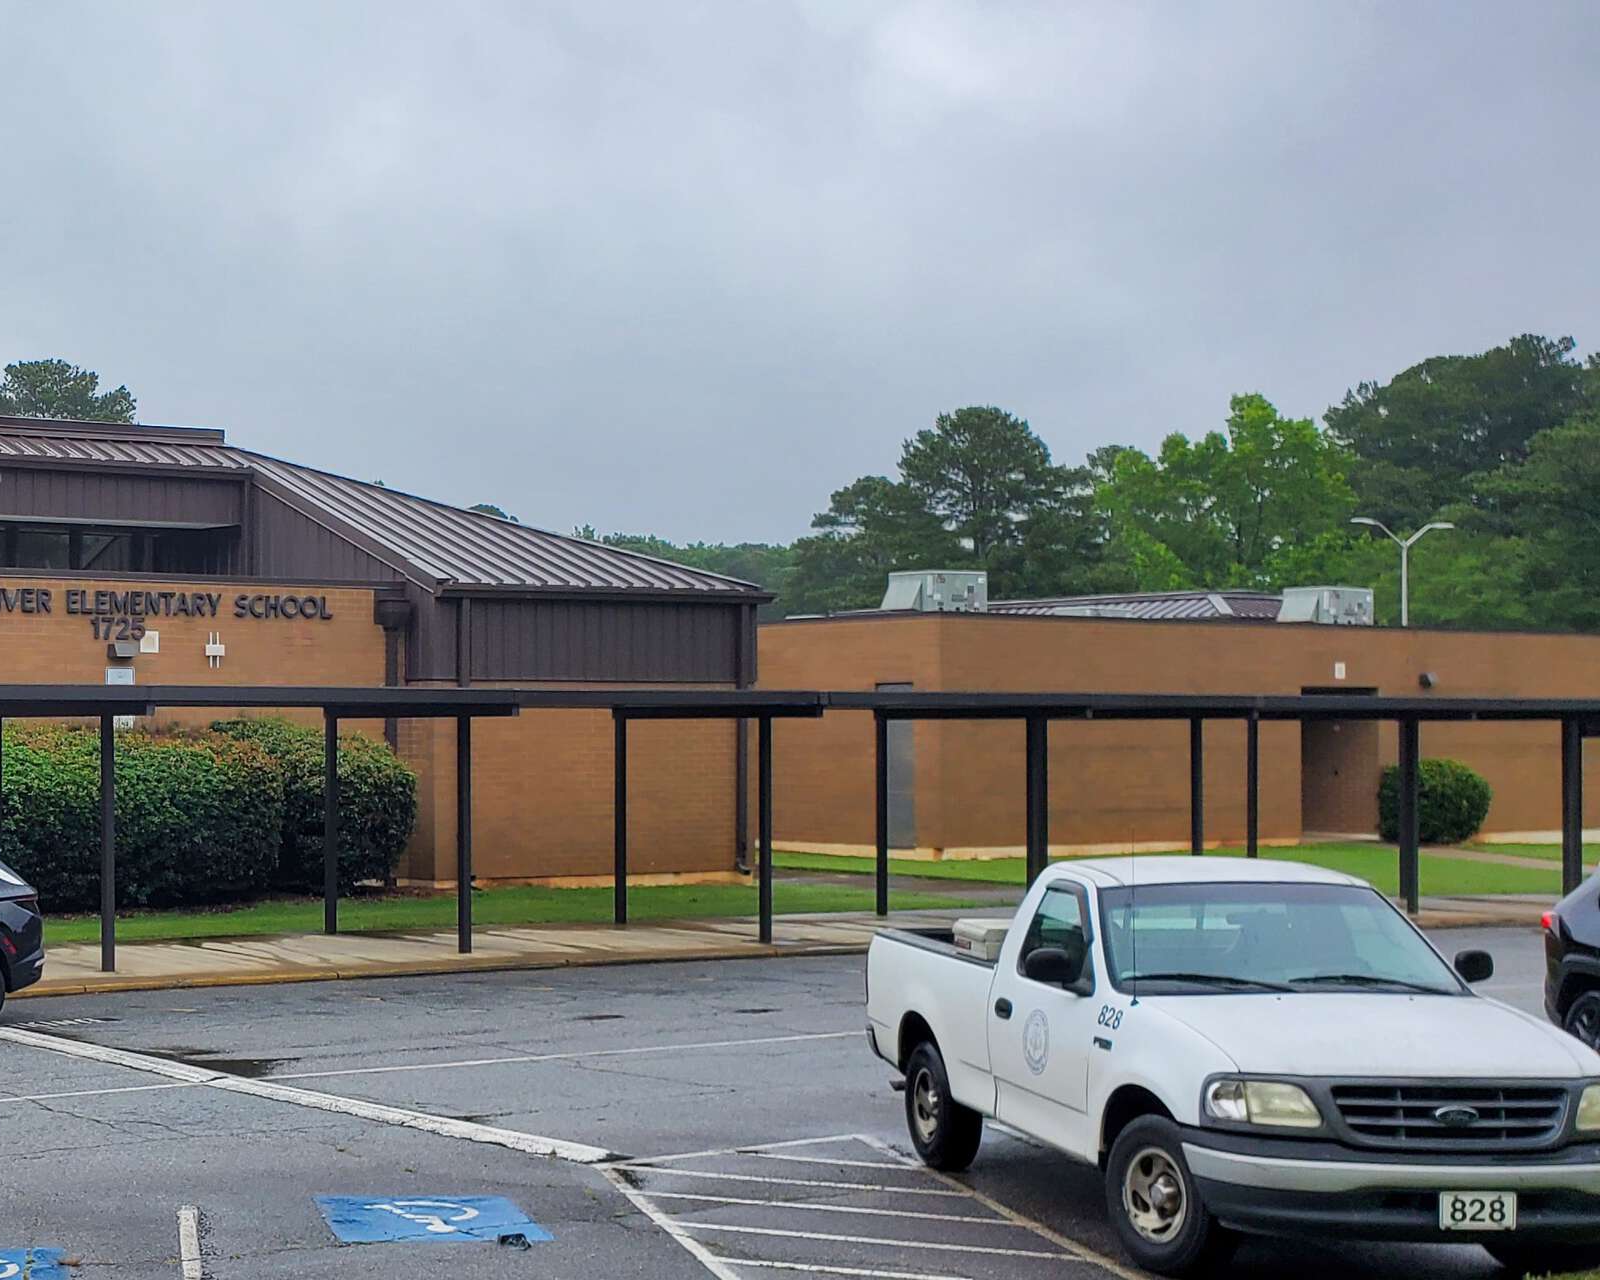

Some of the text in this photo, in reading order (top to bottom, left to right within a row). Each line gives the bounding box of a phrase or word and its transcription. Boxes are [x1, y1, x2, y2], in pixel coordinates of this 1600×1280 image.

[66, 590, 221, 617] ELEMENTARY
[233, 594, 333, 620] SCHOOL
[90, 616, 146, 641] 1725
[1098, 1005, 1123, 1029] 828
[1450, 1198, 1506, 1223] 828
